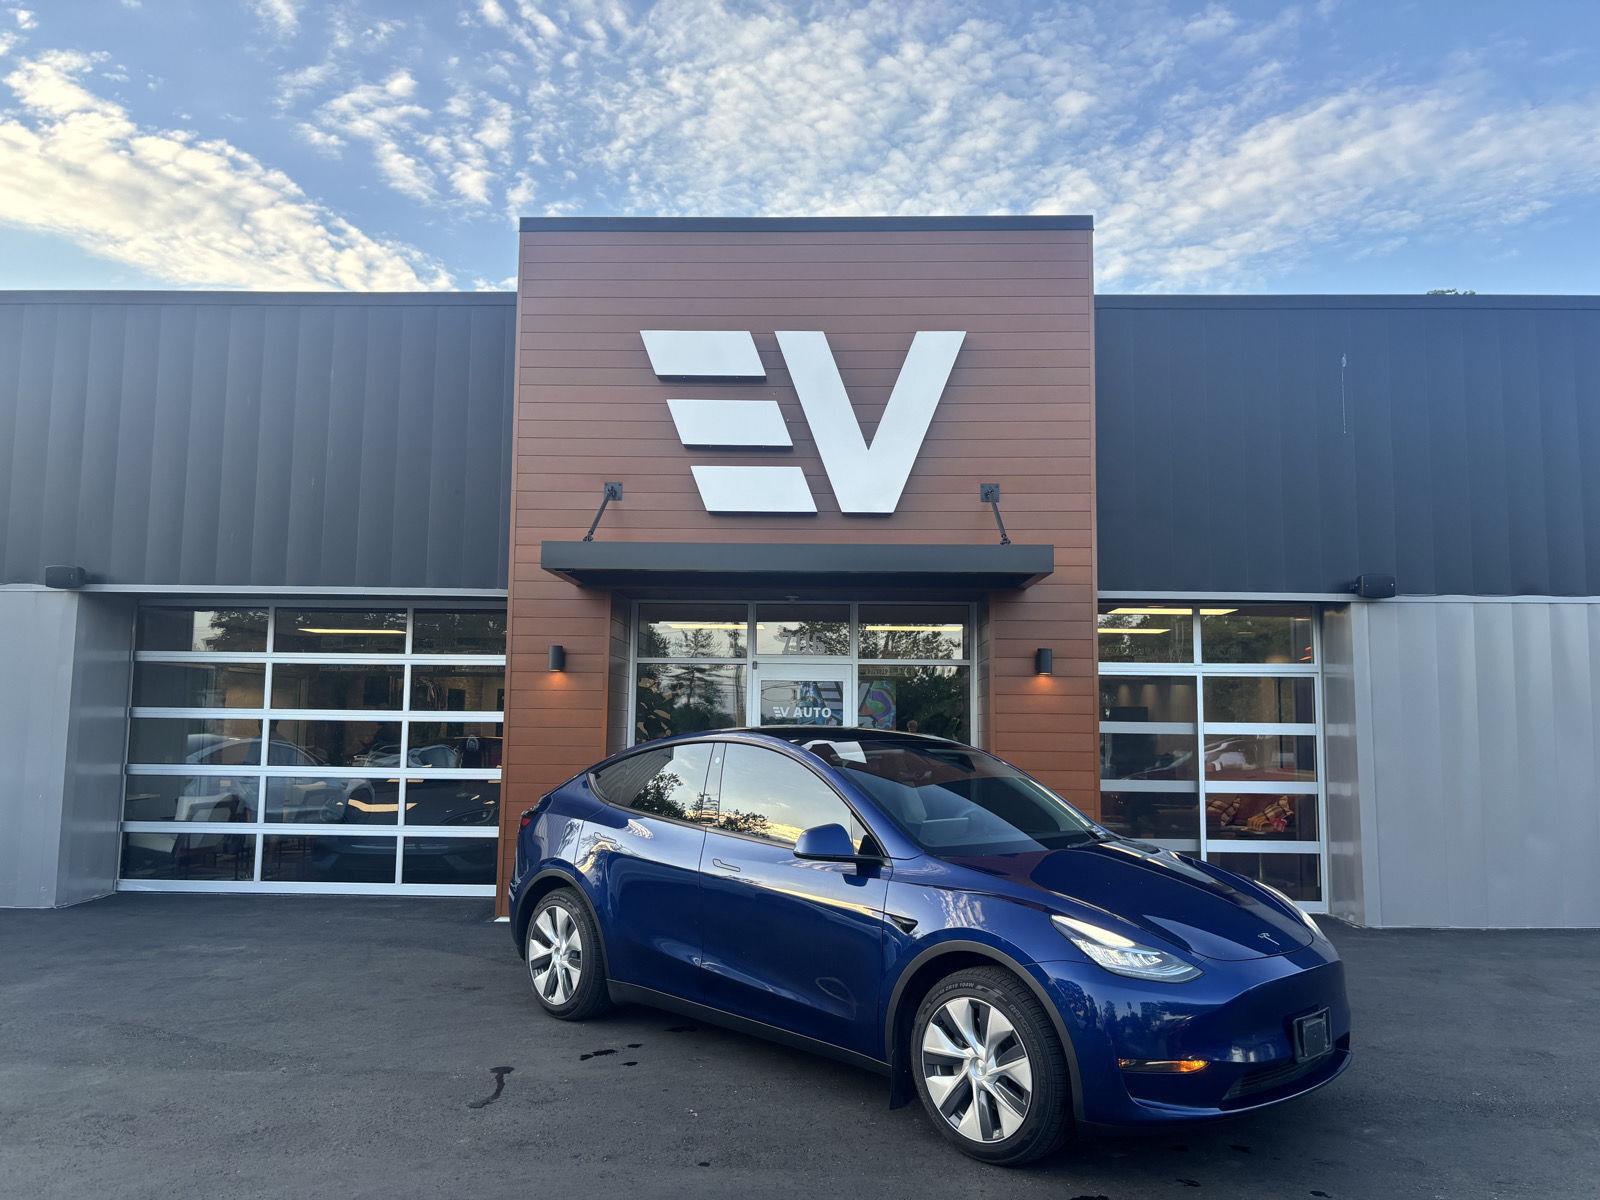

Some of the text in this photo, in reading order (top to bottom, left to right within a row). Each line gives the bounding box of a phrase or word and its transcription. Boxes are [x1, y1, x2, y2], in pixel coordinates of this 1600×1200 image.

[639, 329, 967, 515] EV
[773, 706, 832, 718] EV AUTO
